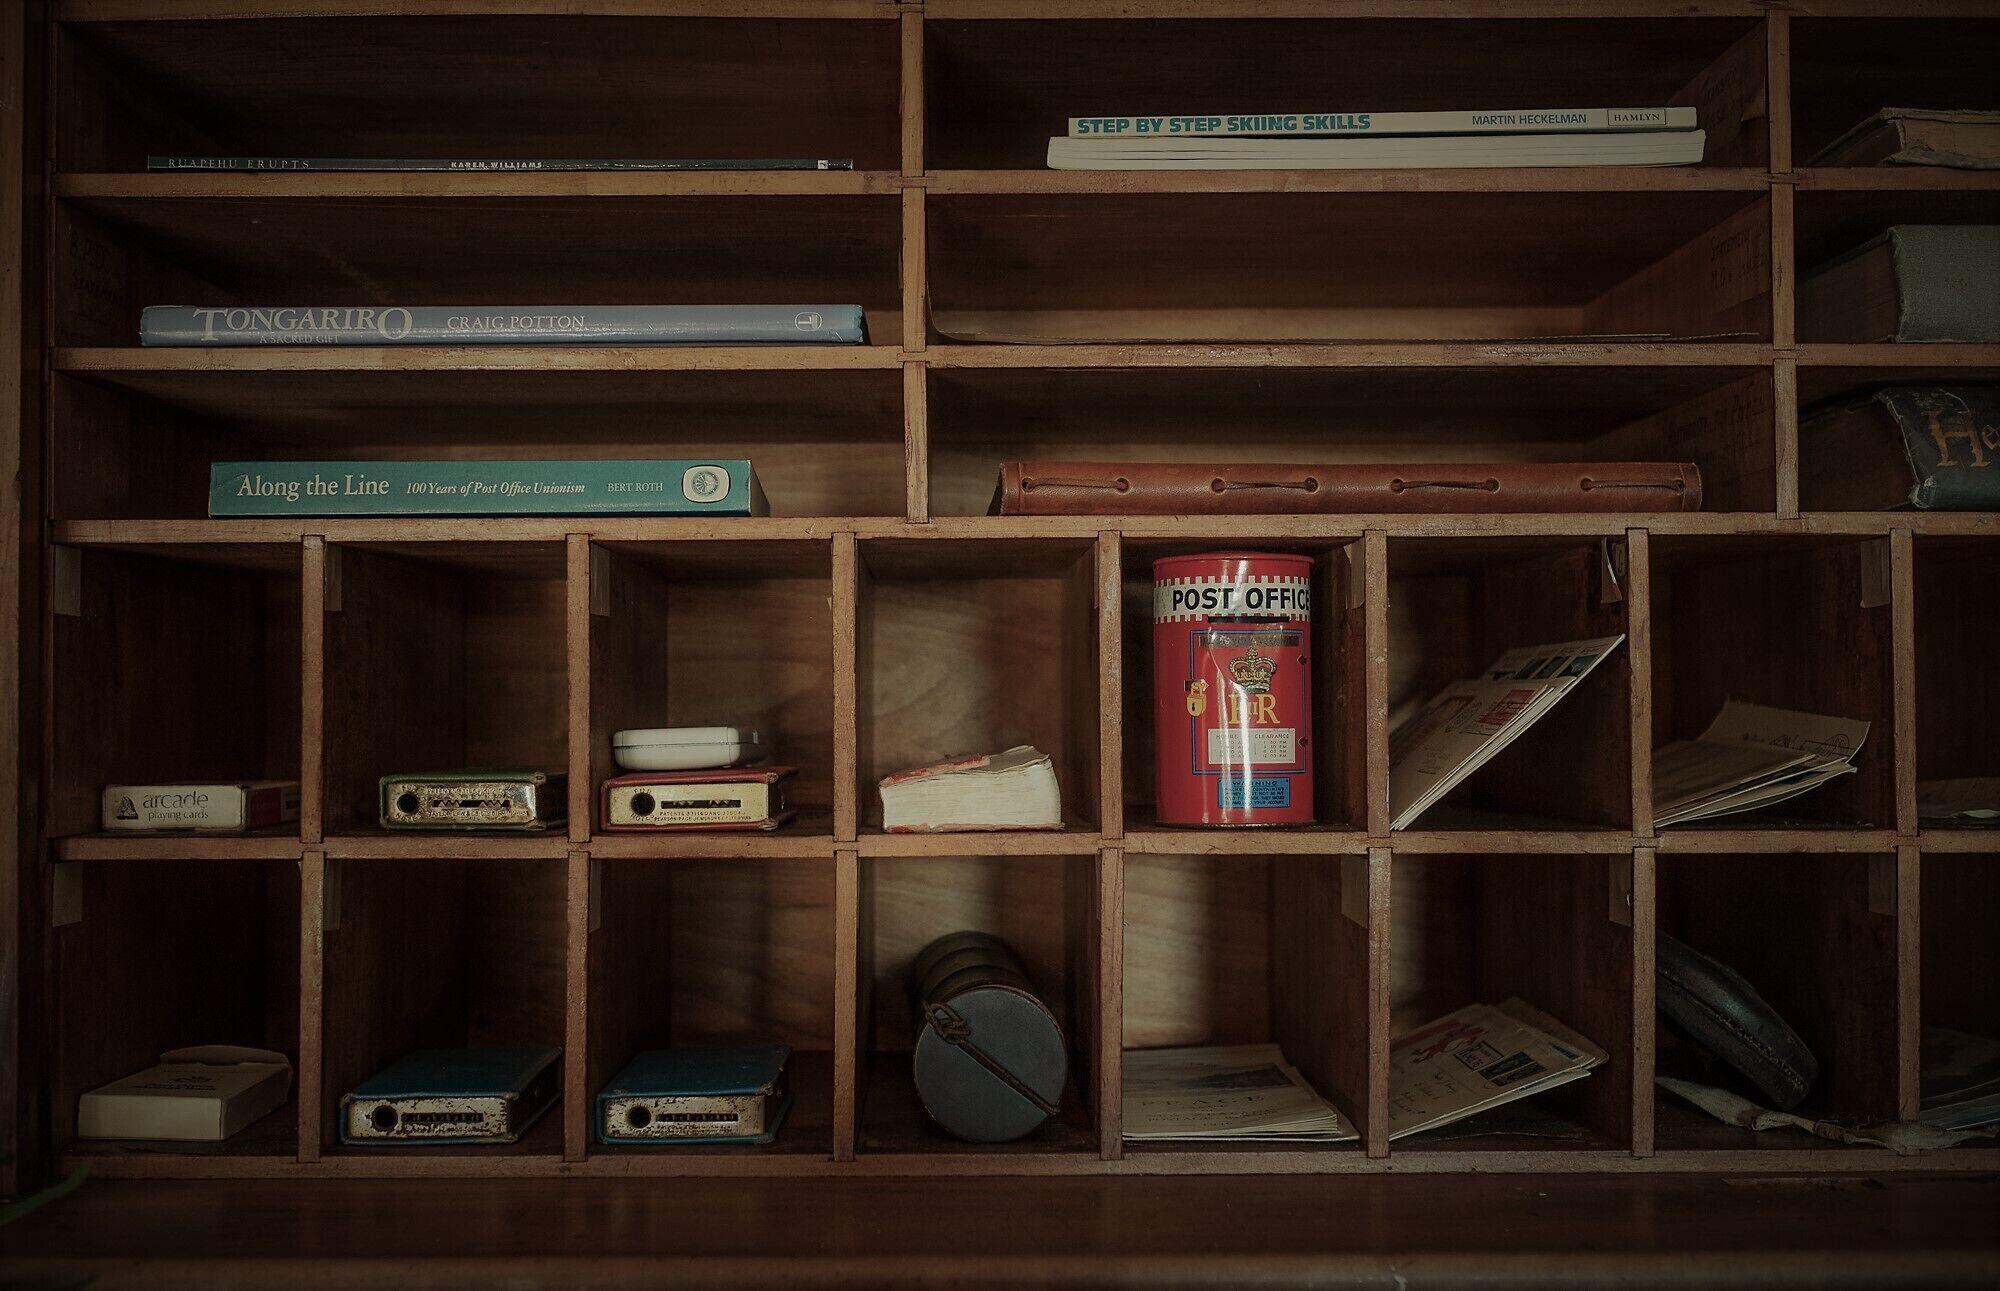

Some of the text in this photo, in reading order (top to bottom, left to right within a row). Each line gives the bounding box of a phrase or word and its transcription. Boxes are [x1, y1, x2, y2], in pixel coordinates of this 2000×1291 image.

[1078, 114, 1371, 133] STEP BY STEP SKIING SKILLS
[1472, 113, 1587, 125] MARTIN HECKELMAN
[1614, 113, 1660, 122] HAMLYN
[168, 159, 310, 169] RUAPEHU ERUPTS
[450, 161, 543, 169] KAREN WILLIAMS
[193, 308, 413, 341] TONGARIRO
[447, 315, 585, 330] CRAIG POTTON
[270, 334, 312, 344] SACRED
[316, 334, 340, 344] GIFT
[236, 474, 390, 502] Along the Line
[406, 481, 586, 497] 100 Years of Post Office Unionism
[607, 482, 663, 492] BERT ROTH
[1172, 587, 1310, 611] POST OFFICE
[143, 791, 209, 809] arcade
[148, 809, 209, 822] playing cards
